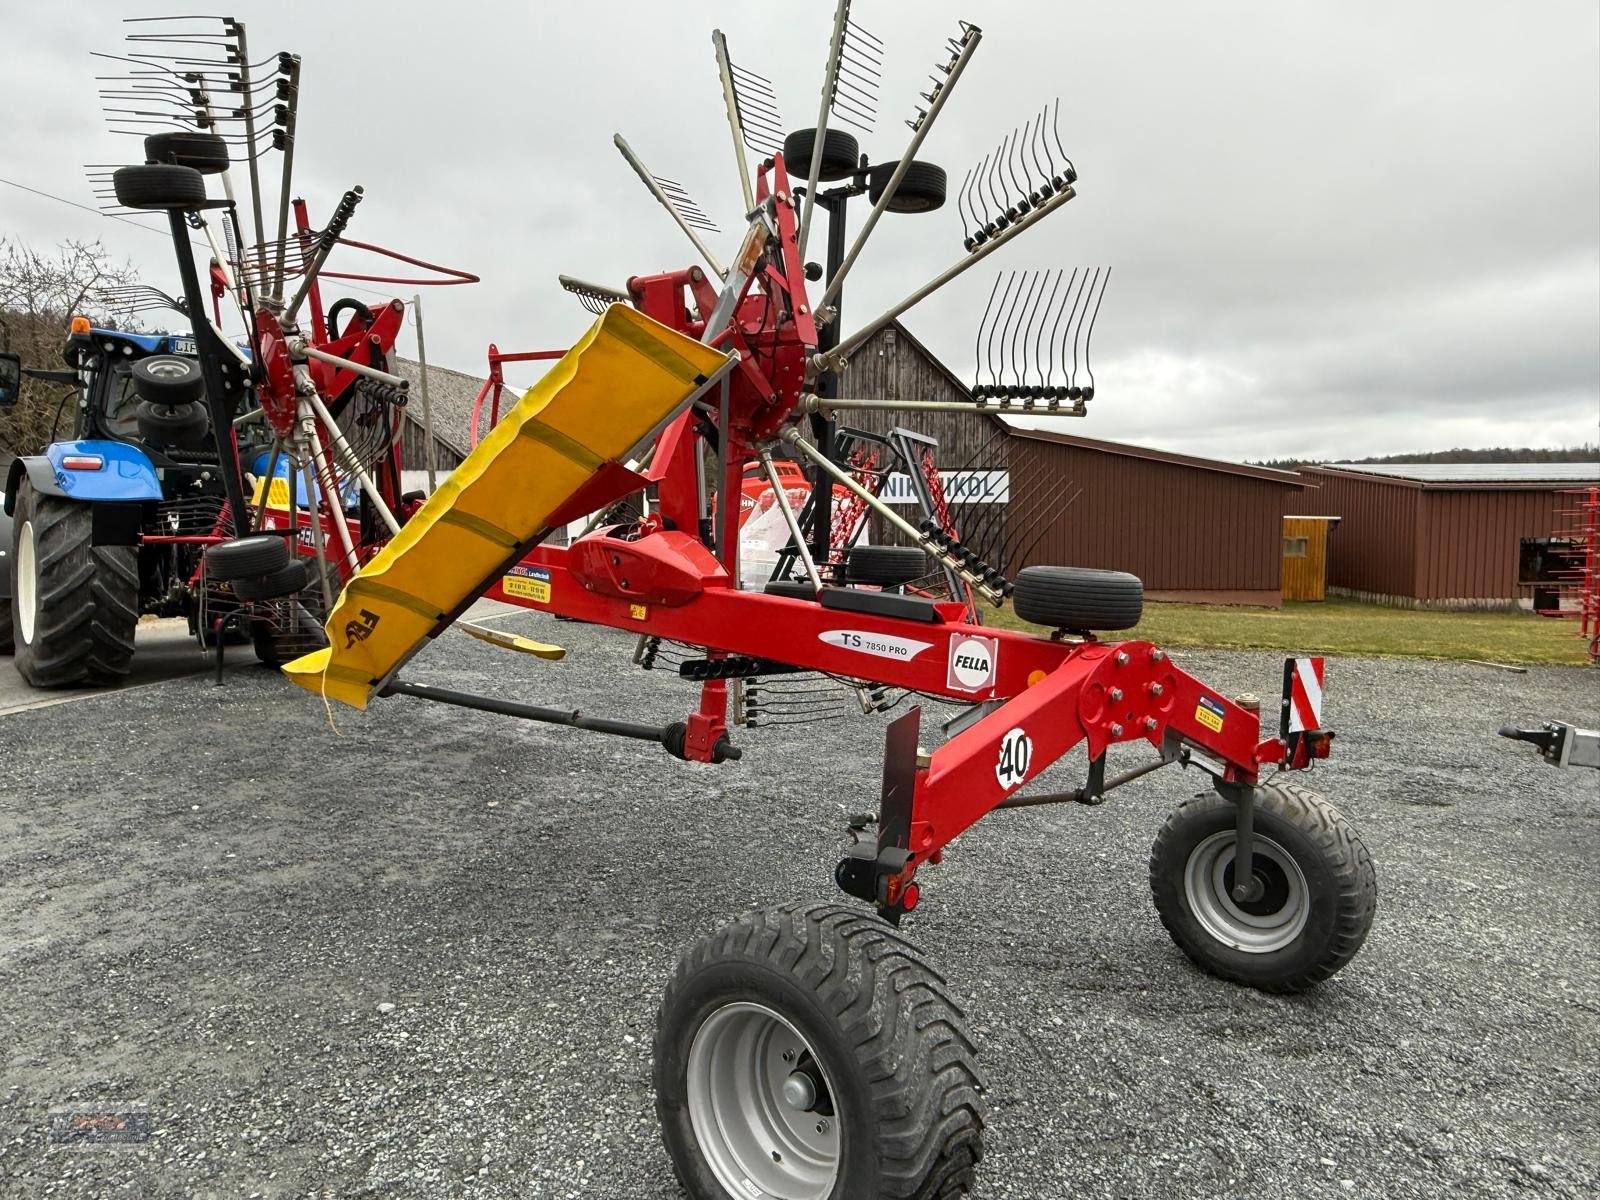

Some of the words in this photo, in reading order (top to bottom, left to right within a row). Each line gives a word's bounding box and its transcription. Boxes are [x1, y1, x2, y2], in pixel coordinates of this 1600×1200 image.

[884, 477, 918, 497] NIK
[941, 476, 995, 497] IKOL
[741, 499, 755, 508] HN
[841, 633, 862, 647] TS
[865, 641, 887, 652] 7850
[888, 645, 908, 656] PRO
[954, 655, 990, 673] FELLA
[1000, 734, 1028, 782] 40
